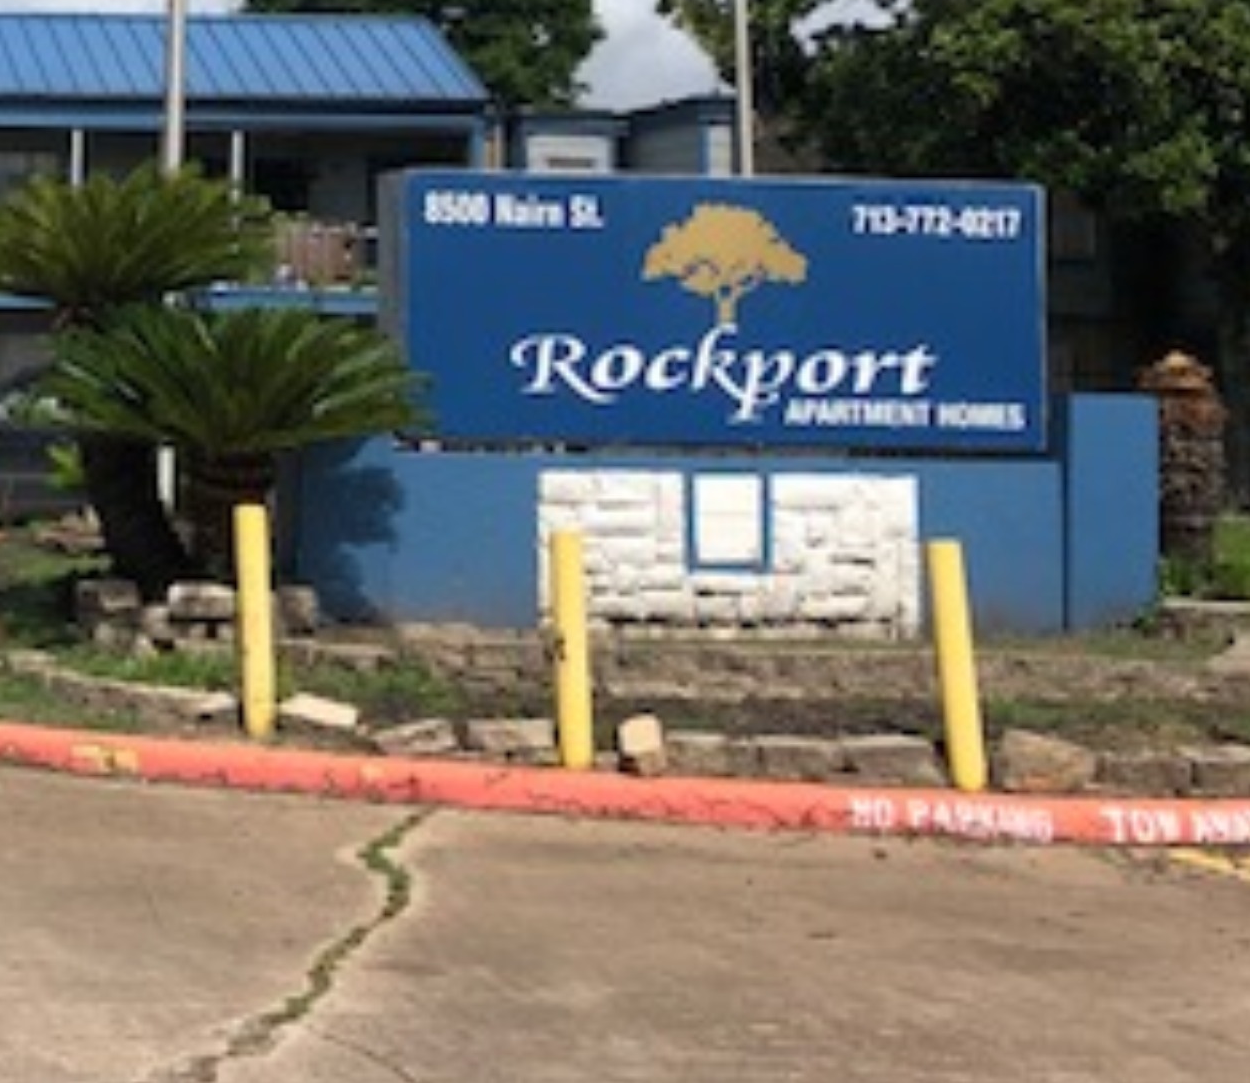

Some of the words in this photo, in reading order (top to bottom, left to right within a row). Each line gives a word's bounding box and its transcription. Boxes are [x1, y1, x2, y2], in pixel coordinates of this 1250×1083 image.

[424, 190, 490, 226] 8500
[510, 322, 937, 425] Rockport
[784, 397, 931, 427] APARTMENT
[938, 402, 1026, 432] HOMES
[852, 797, 893, 830] NO
[905, 798, 1053, 843] PARKING
